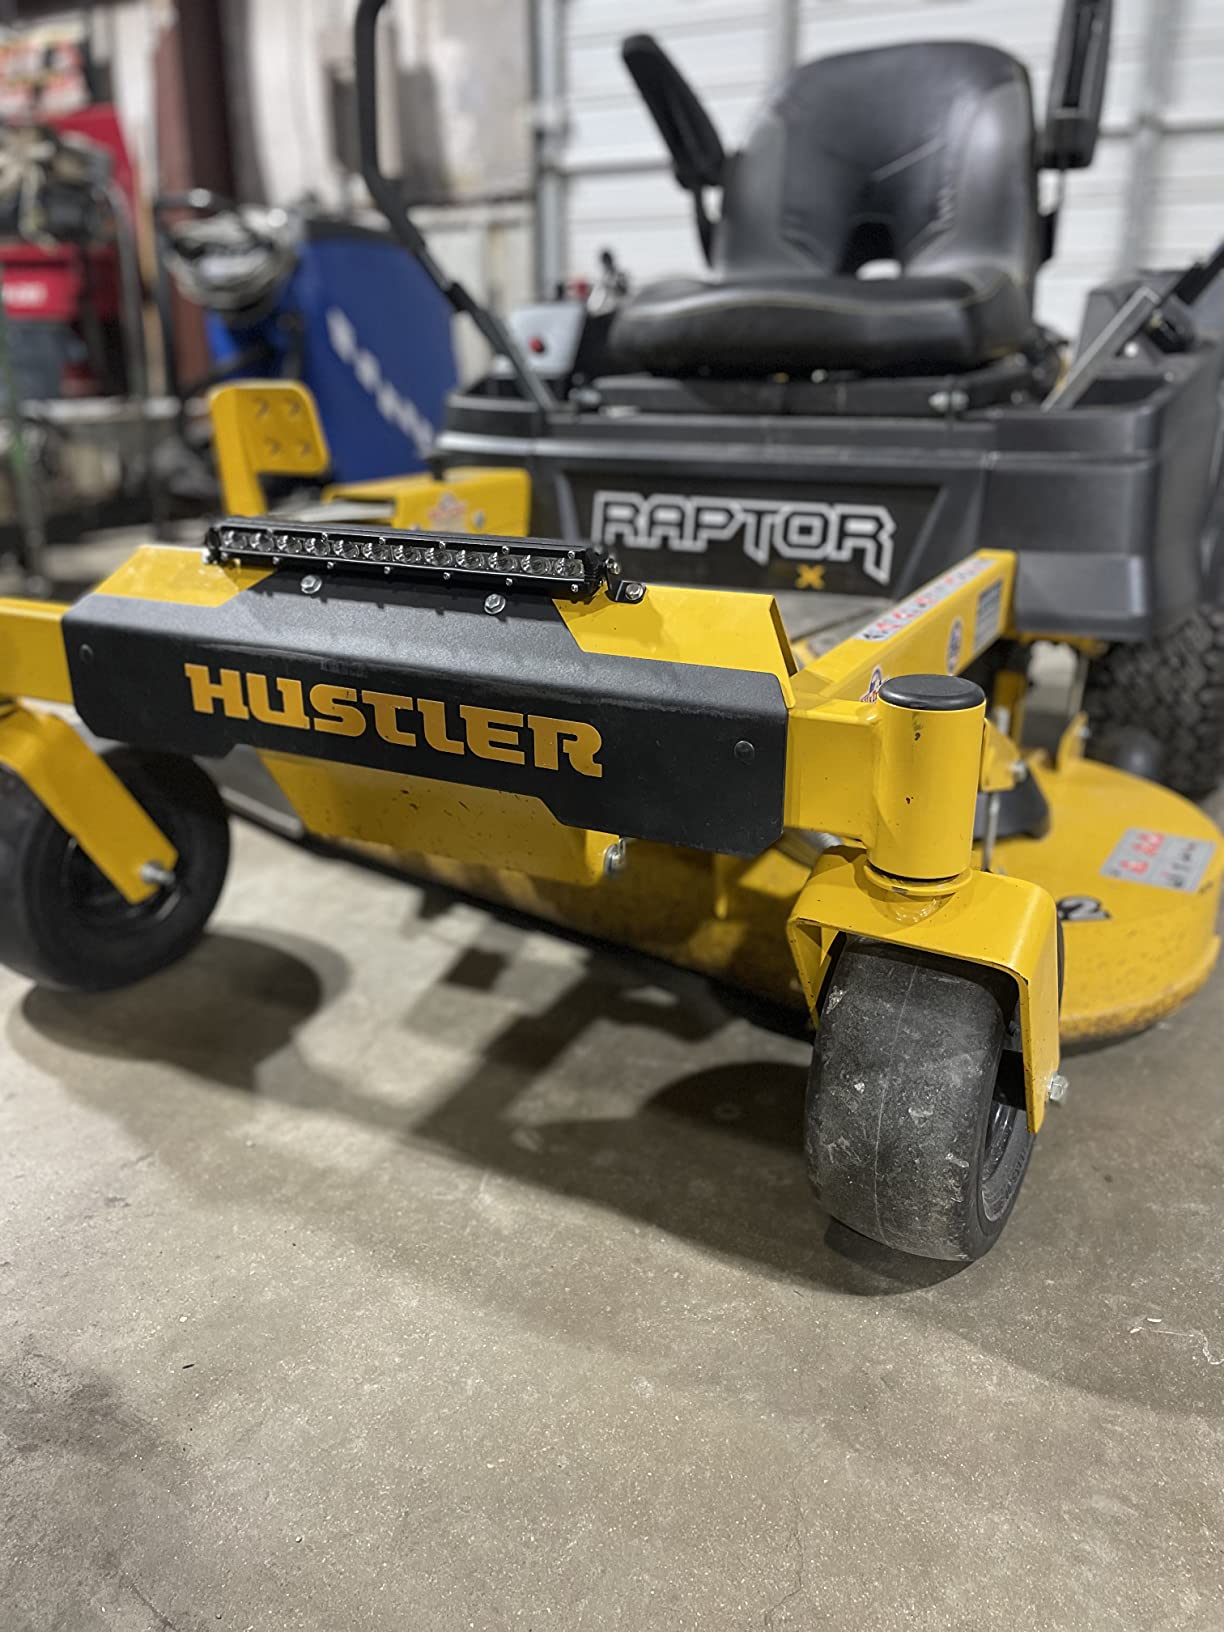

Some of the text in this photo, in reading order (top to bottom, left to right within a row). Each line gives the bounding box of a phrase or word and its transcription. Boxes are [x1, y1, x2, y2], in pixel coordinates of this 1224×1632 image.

[591, 490, 896, 585] RAPTOR
[183, 662, 603, 778] HUSTLER
[1057, 895, 1111, 921] 2
